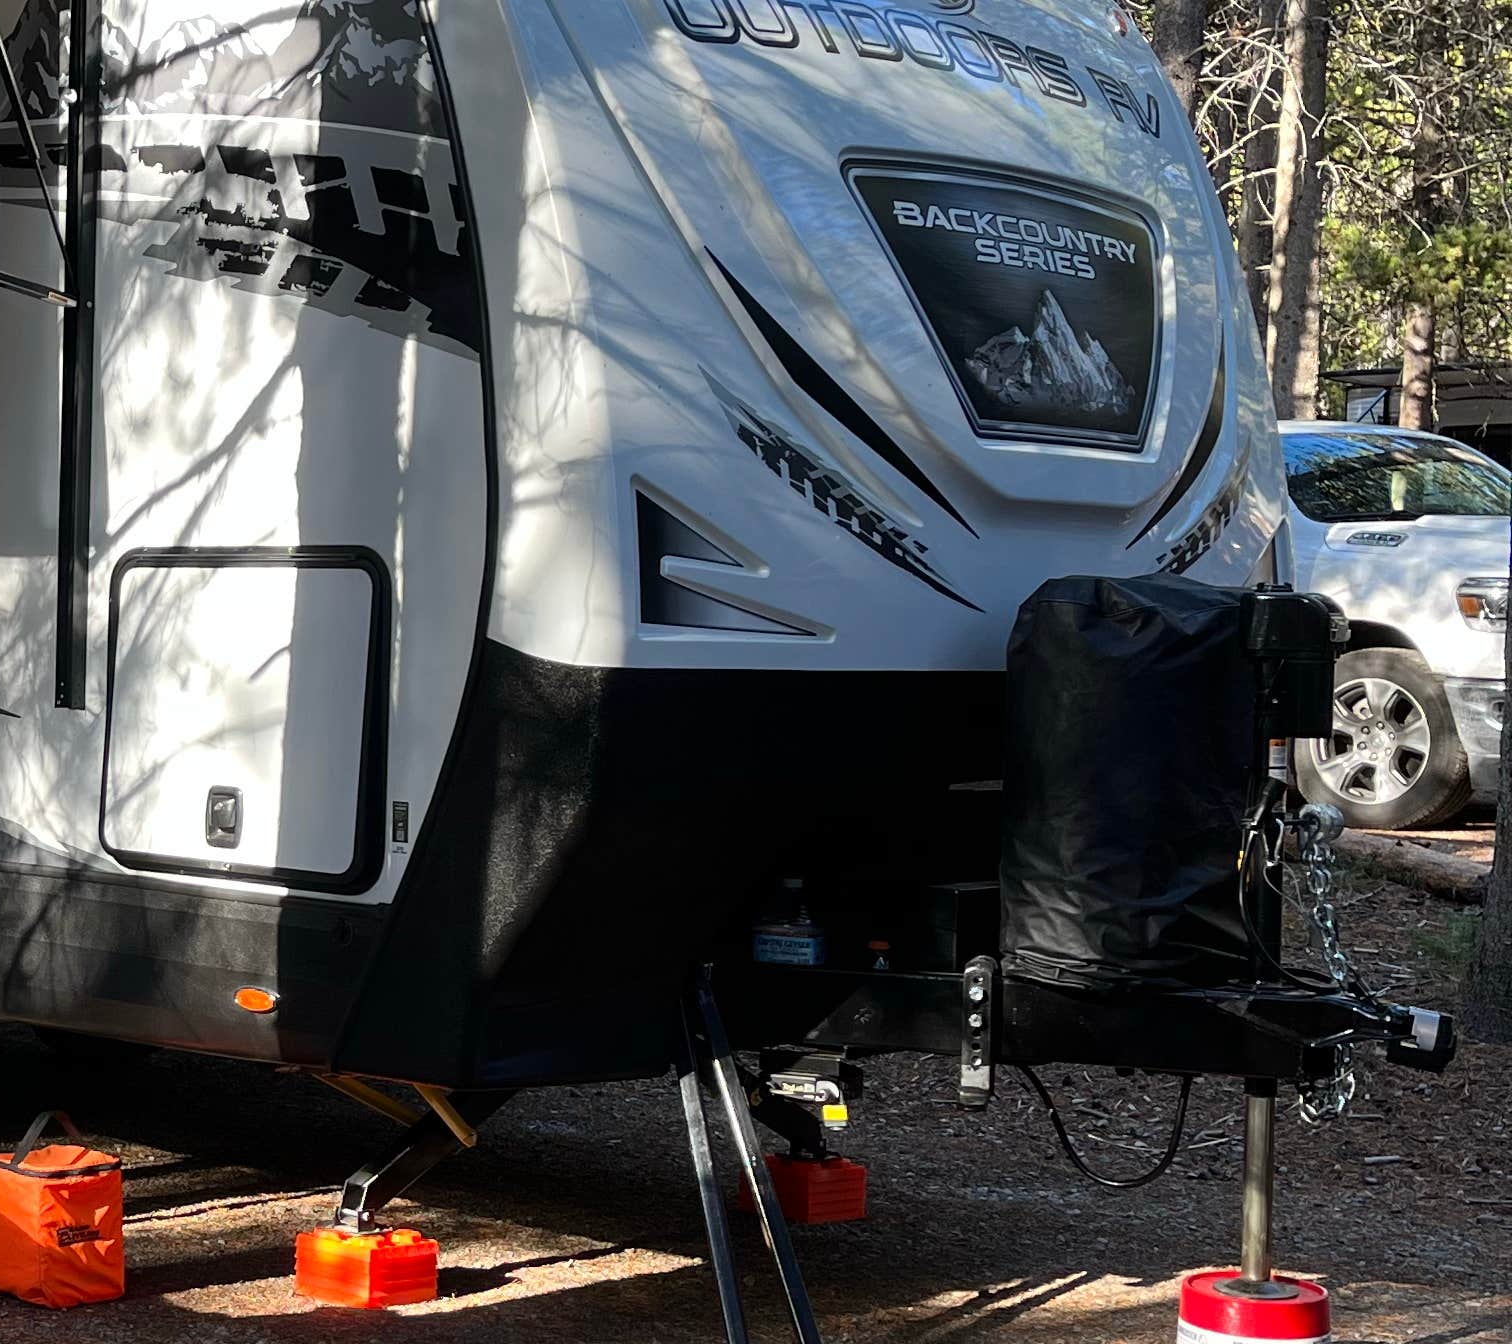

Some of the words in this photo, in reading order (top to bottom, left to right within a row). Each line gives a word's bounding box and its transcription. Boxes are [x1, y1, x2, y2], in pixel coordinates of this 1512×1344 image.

[1085, 65, 1161, 139] RV
[892, 200, 1137, 264] BACKCOUNTRY
[974, 238, 1096, 280] SERIES
